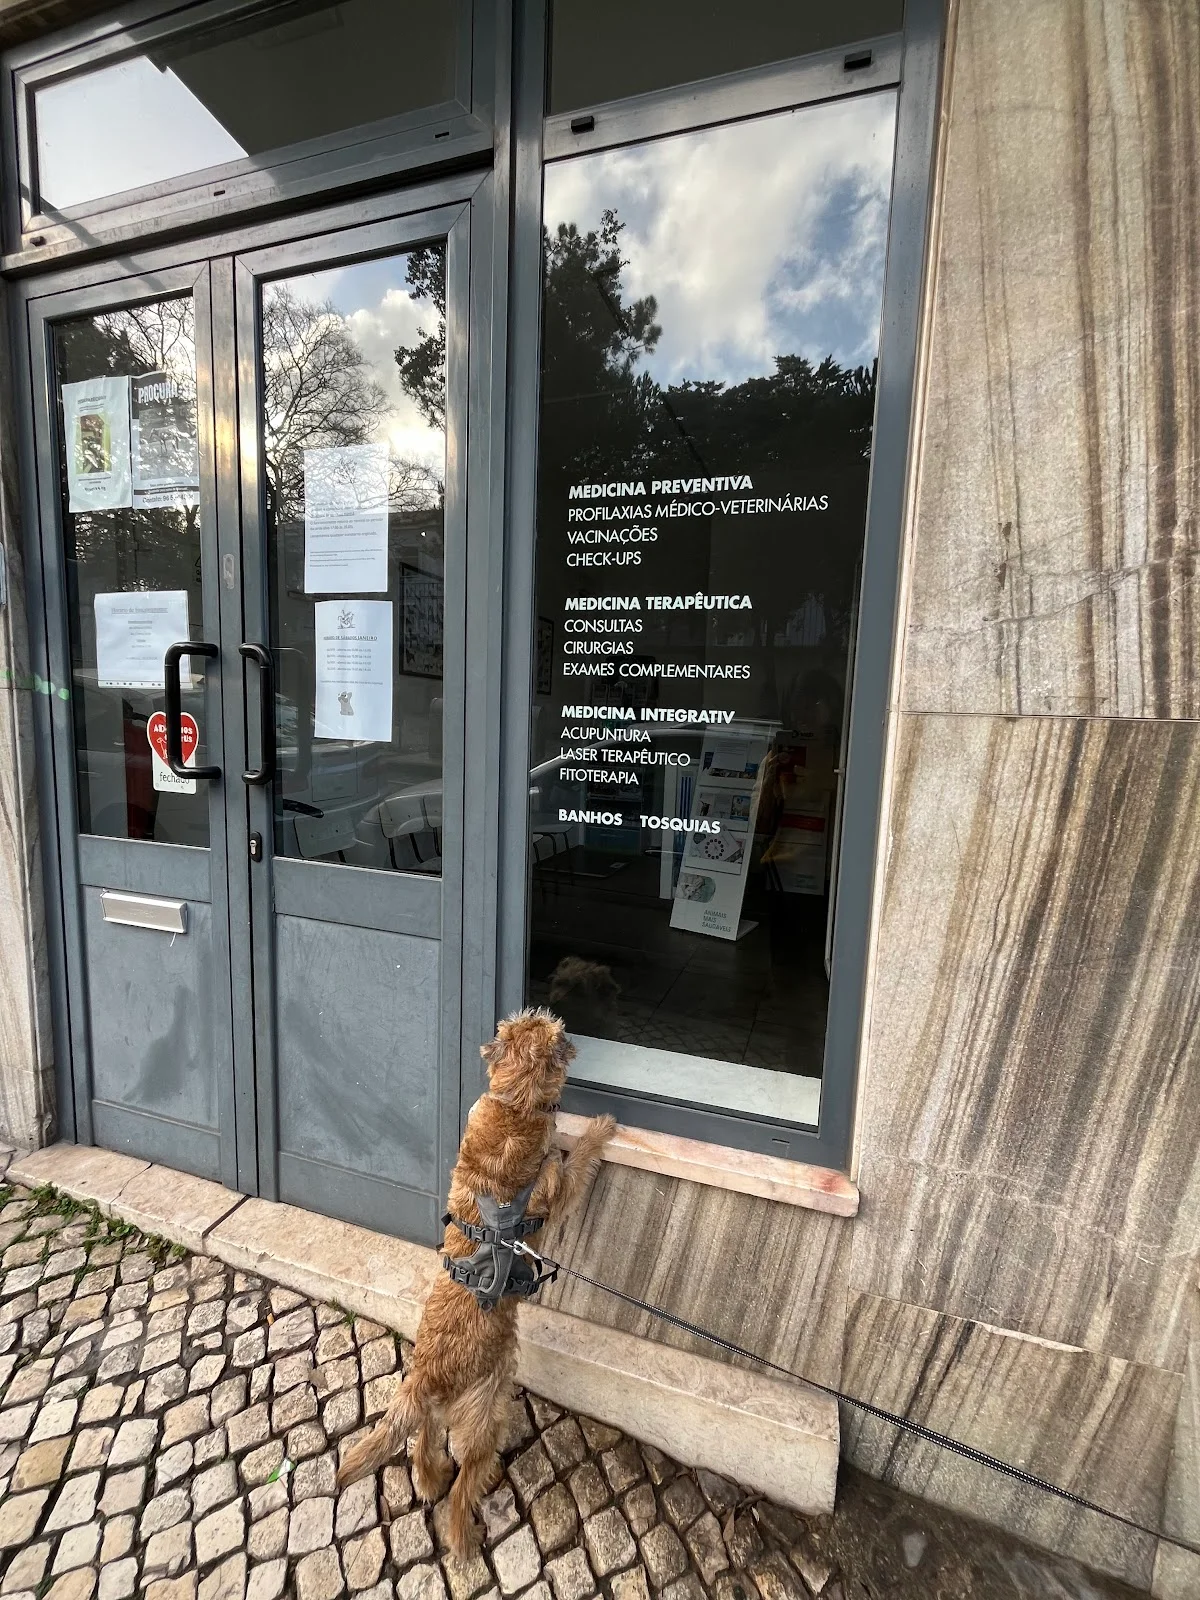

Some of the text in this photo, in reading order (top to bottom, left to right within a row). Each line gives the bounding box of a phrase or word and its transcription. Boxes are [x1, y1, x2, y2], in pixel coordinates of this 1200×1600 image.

[569, 475, 753, 499] MEDICINA PREVENTIVA
[569, 493, 828, 522] PROFILAXIAS MÉDICO-VETERINÁRIAS
[567, 525, 657, 544] VACINAÇÕES
[567, 551, 641, 566] CHECK-UPS
[565, 592, 752, 610] MEDICINA TERAPÊUTICA
[565, 619, 642, 633] CONSULTAS
[564, 641, 633, 654] CIRURGIAS
[564, 663, 750, 679] EXAMES COMPLEMENTARES
[562, 706, 735, 724] MEDICINA INTEGRATIV
[561, 727, 651, 742] ACUPUNTURA
[560, 747, 690, 766] LASER TERAPÊUTICO
[560, 768, 639, 784] FITOTERAPIA
[559, 809, 720, 834] BANHOS TOSQUIAS
